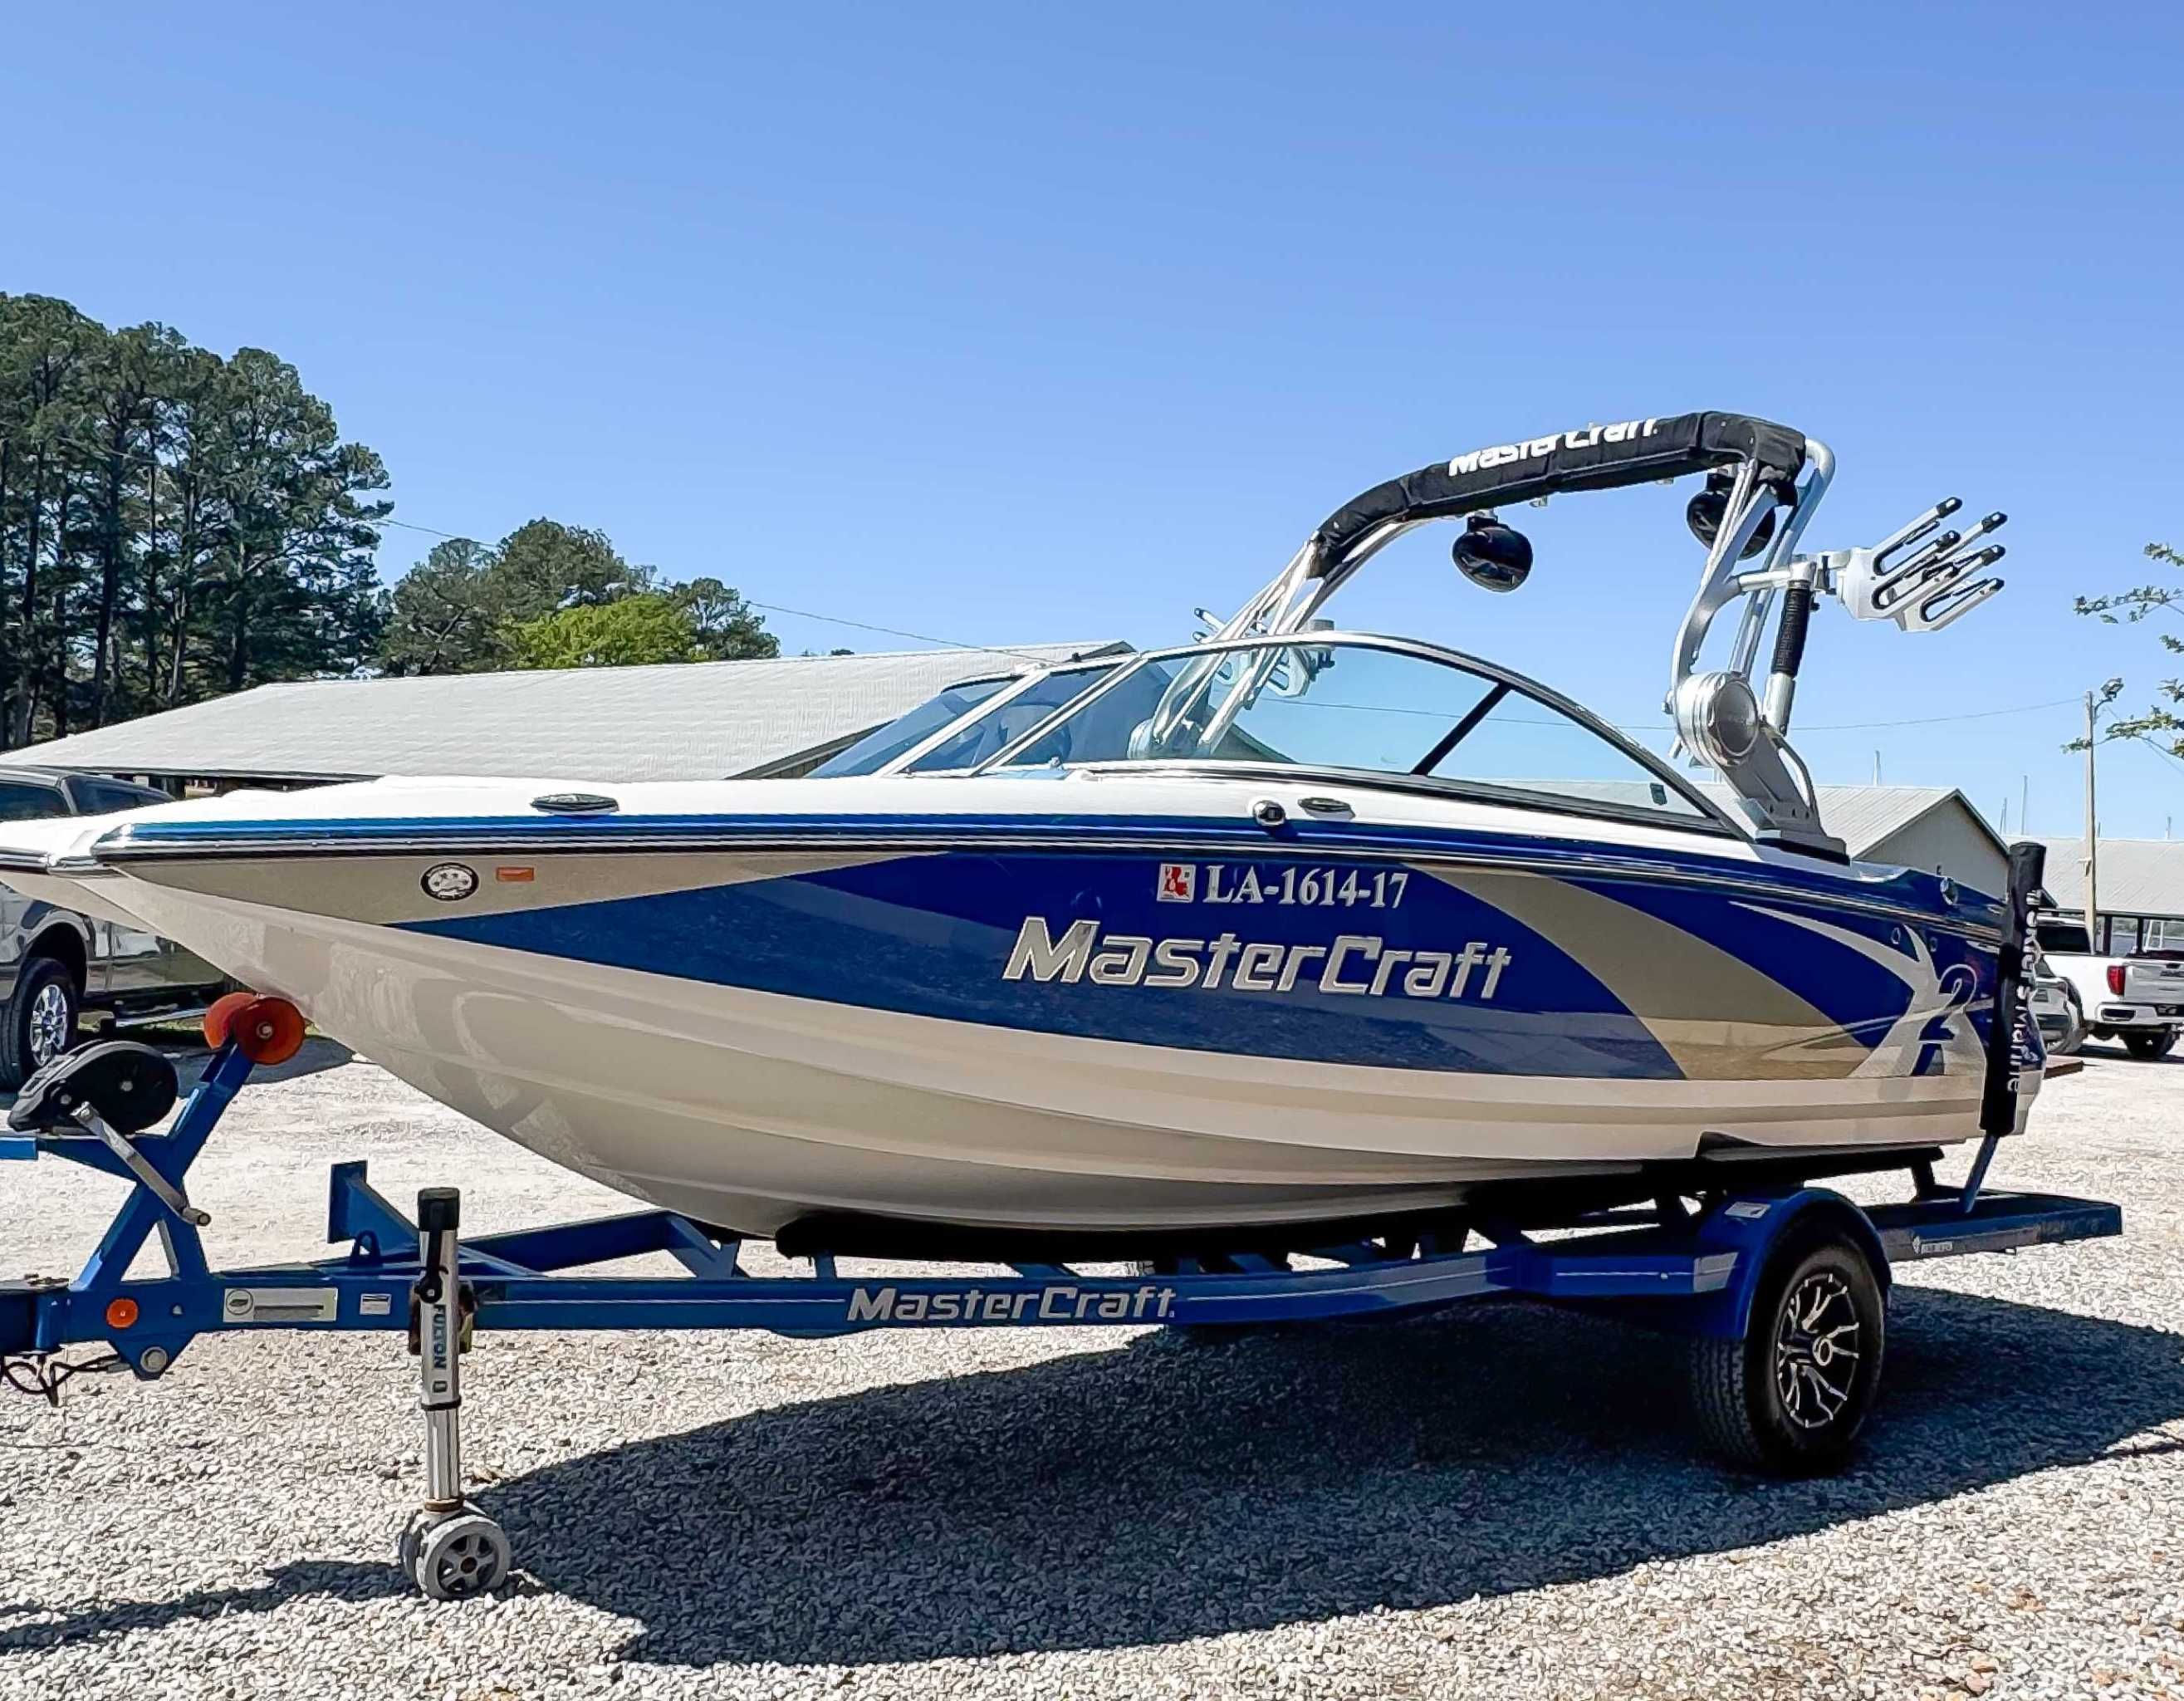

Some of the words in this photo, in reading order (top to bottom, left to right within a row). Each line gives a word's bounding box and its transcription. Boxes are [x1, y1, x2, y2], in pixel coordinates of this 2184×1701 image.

[1202, 865, 1409, 909] LA-1614-17
[1001, 916, 1513, 998] MasterCraft
[846, 1287, 1176, 1322] MasterCraft
[432, 1304, 448, 1369] FULTON
